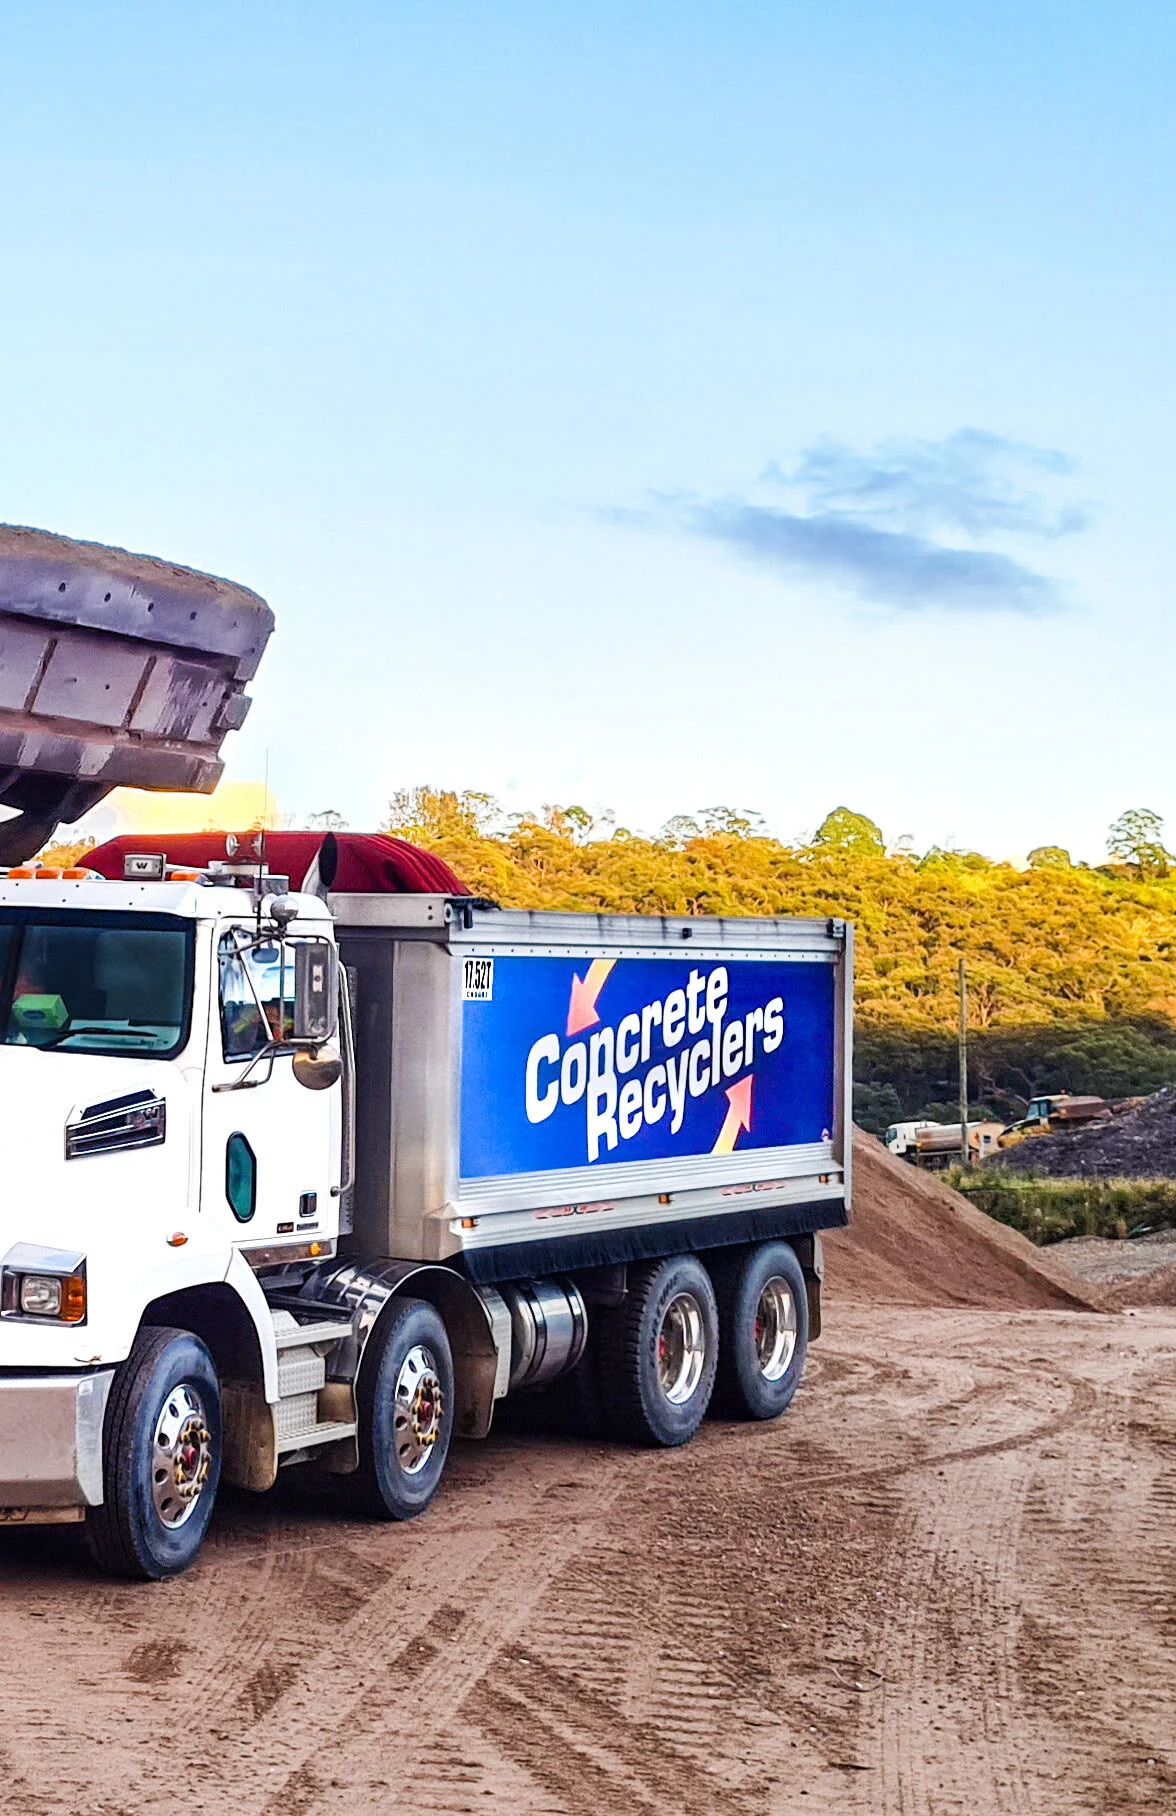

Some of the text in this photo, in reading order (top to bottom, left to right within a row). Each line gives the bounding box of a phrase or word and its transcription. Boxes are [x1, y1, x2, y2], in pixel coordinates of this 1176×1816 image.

[464, 960, 492, 990] 17.52T
[525, 966, 729, 1124] Concrete
[586, 997, 784, 1163] Recyclers
